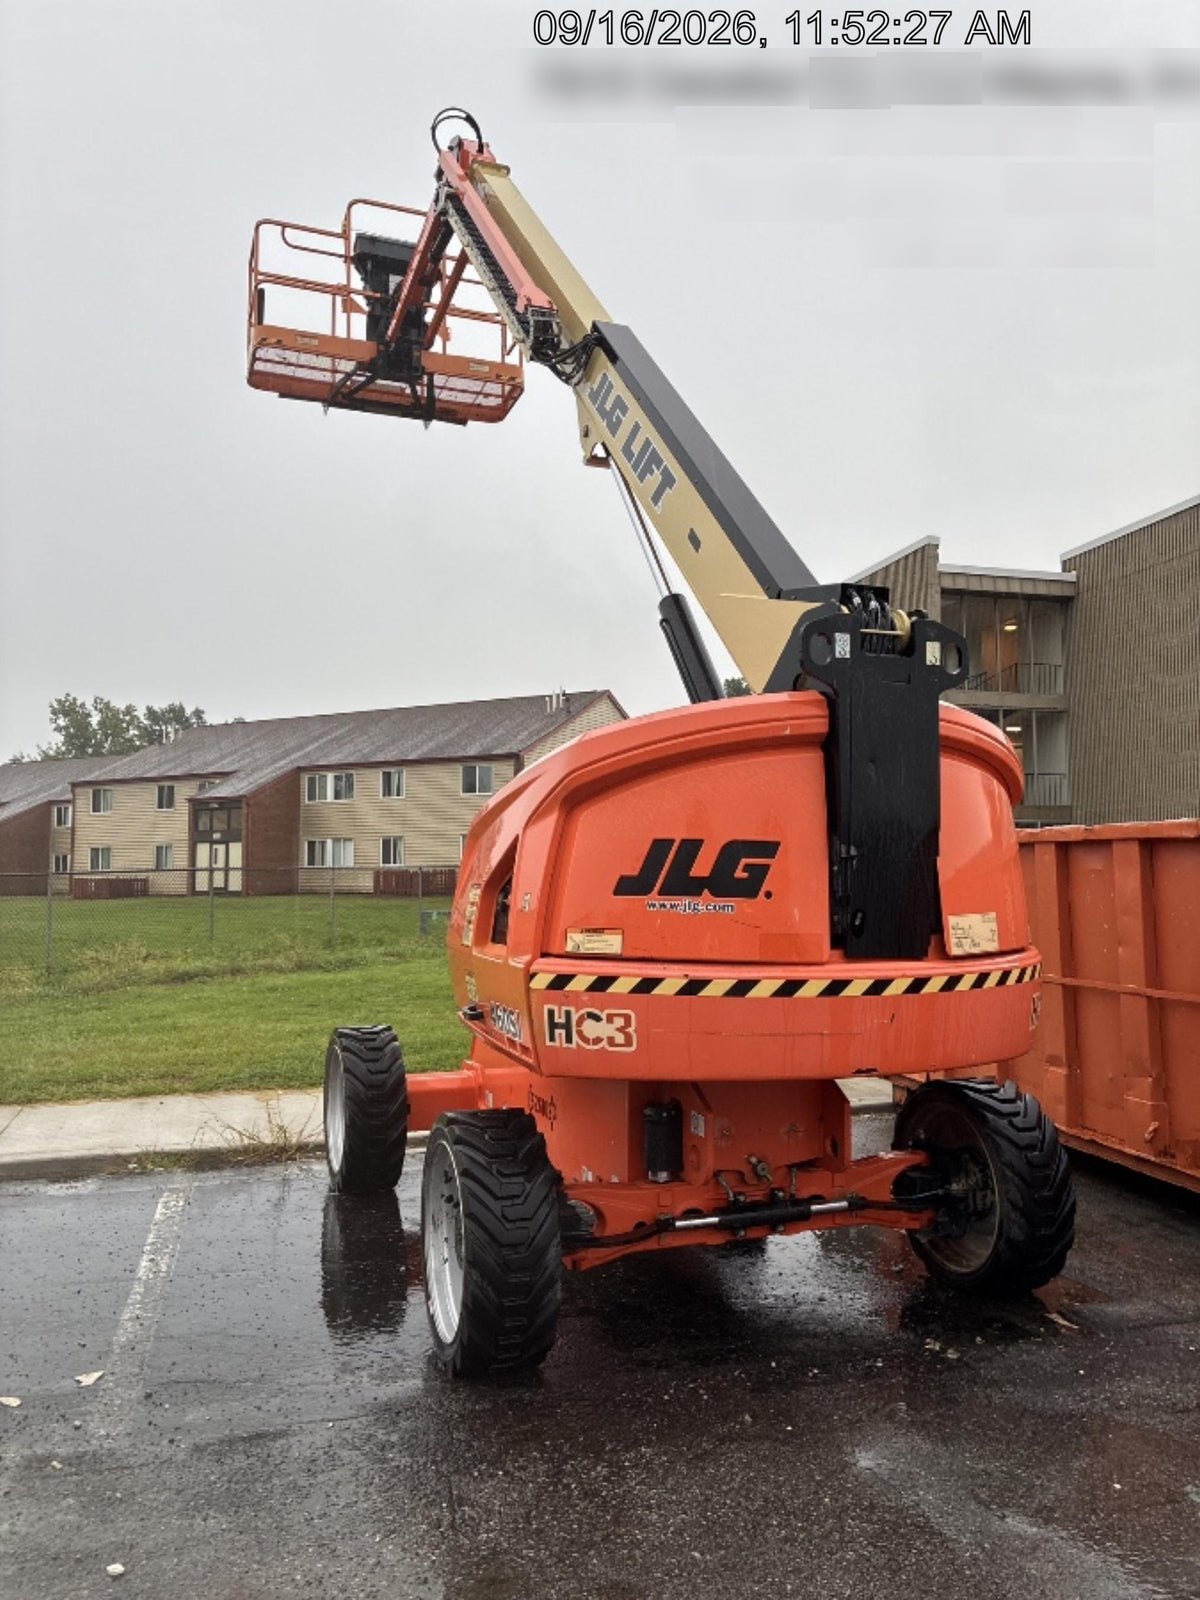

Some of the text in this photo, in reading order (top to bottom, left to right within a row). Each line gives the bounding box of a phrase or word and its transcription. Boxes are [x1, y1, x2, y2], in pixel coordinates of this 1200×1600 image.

[588, 371, 677, 509] JLG LIFT
[646, 898, 735, 914] www.jlg.com
[544, 1004, 637, 1051] HC3
